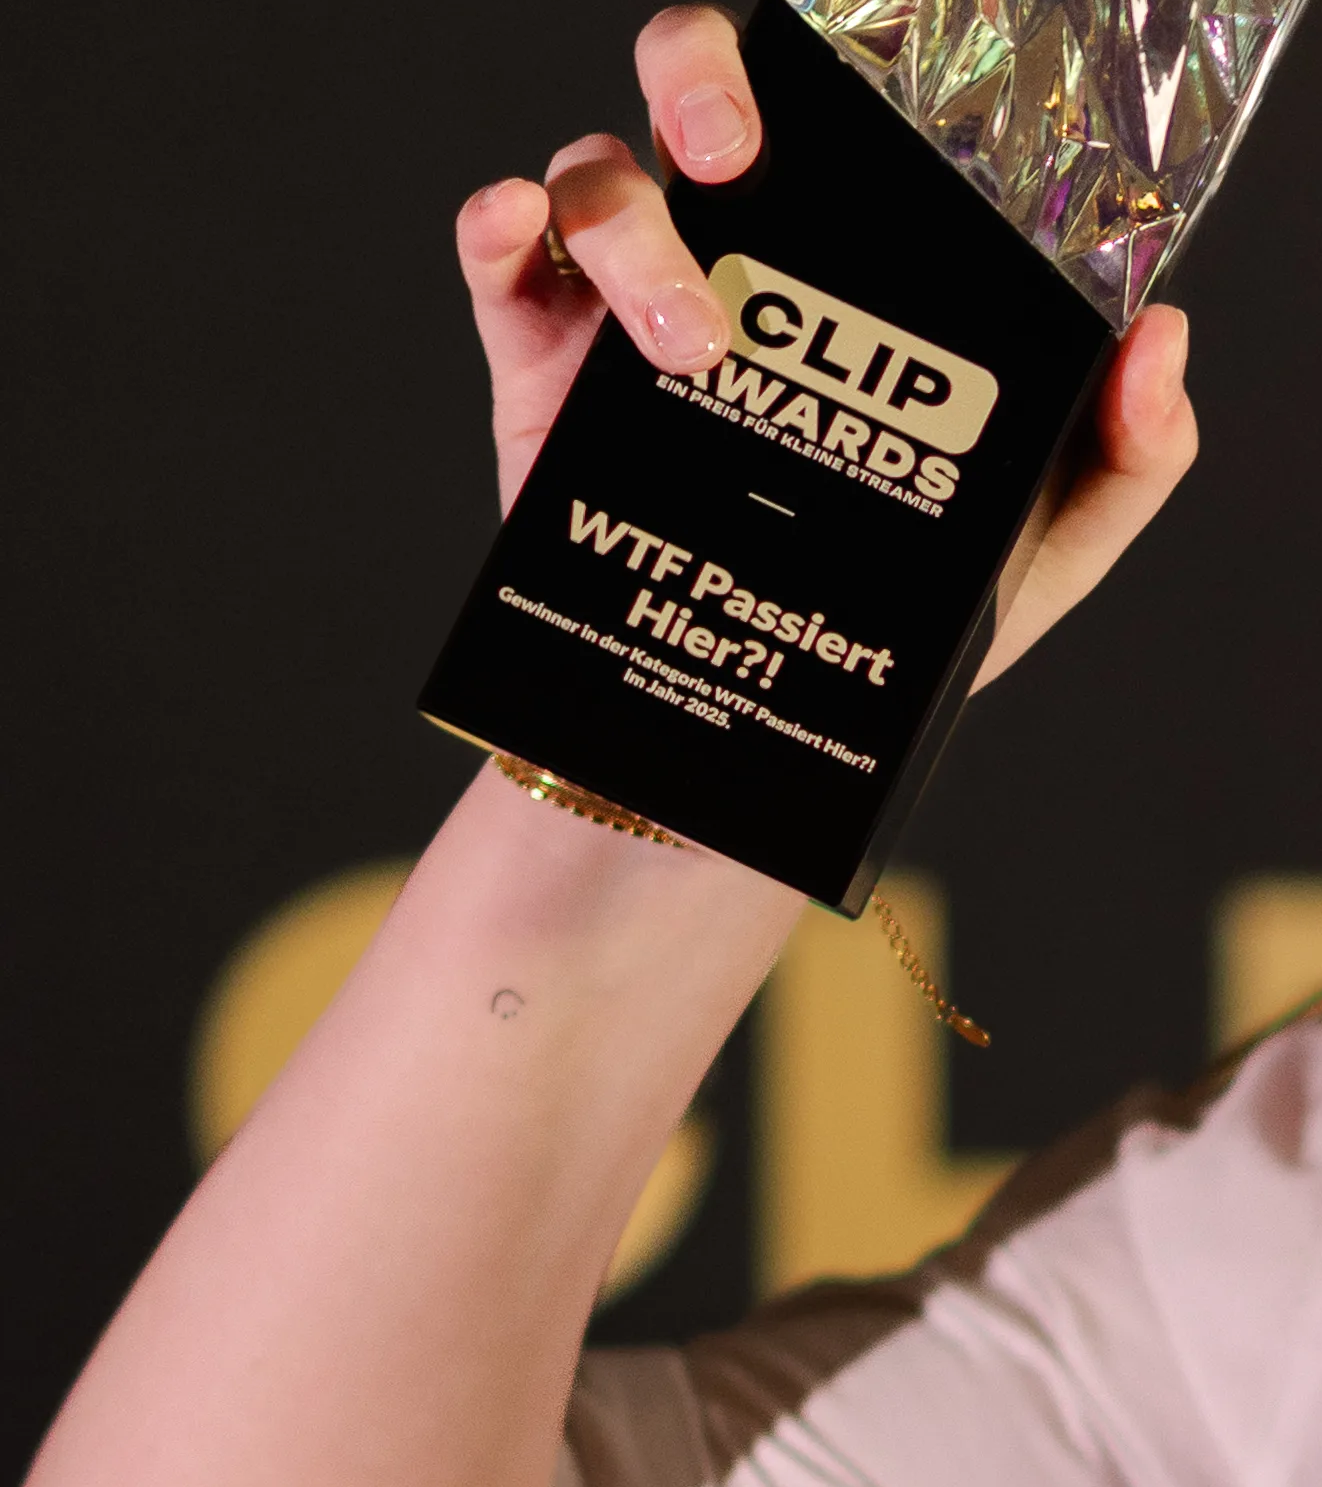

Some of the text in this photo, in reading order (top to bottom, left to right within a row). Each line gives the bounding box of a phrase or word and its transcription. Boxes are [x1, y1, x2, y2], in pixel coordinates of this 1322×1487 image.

[740, 290, 953, 413] CLIP
[655, 374, 944, 518] EIN PREIS FÜR KLEINE STREAMER
[569, 499, 895, 686] WTF Passiert
[626, 588, 785, 690] Hier?!
[498, 586, 877, 773] Gewinner in der Kategorie WTF Passiert Hier?!
[645, 679, 685, 706] Jahr
[683, 697, 731, 730] 2025.
